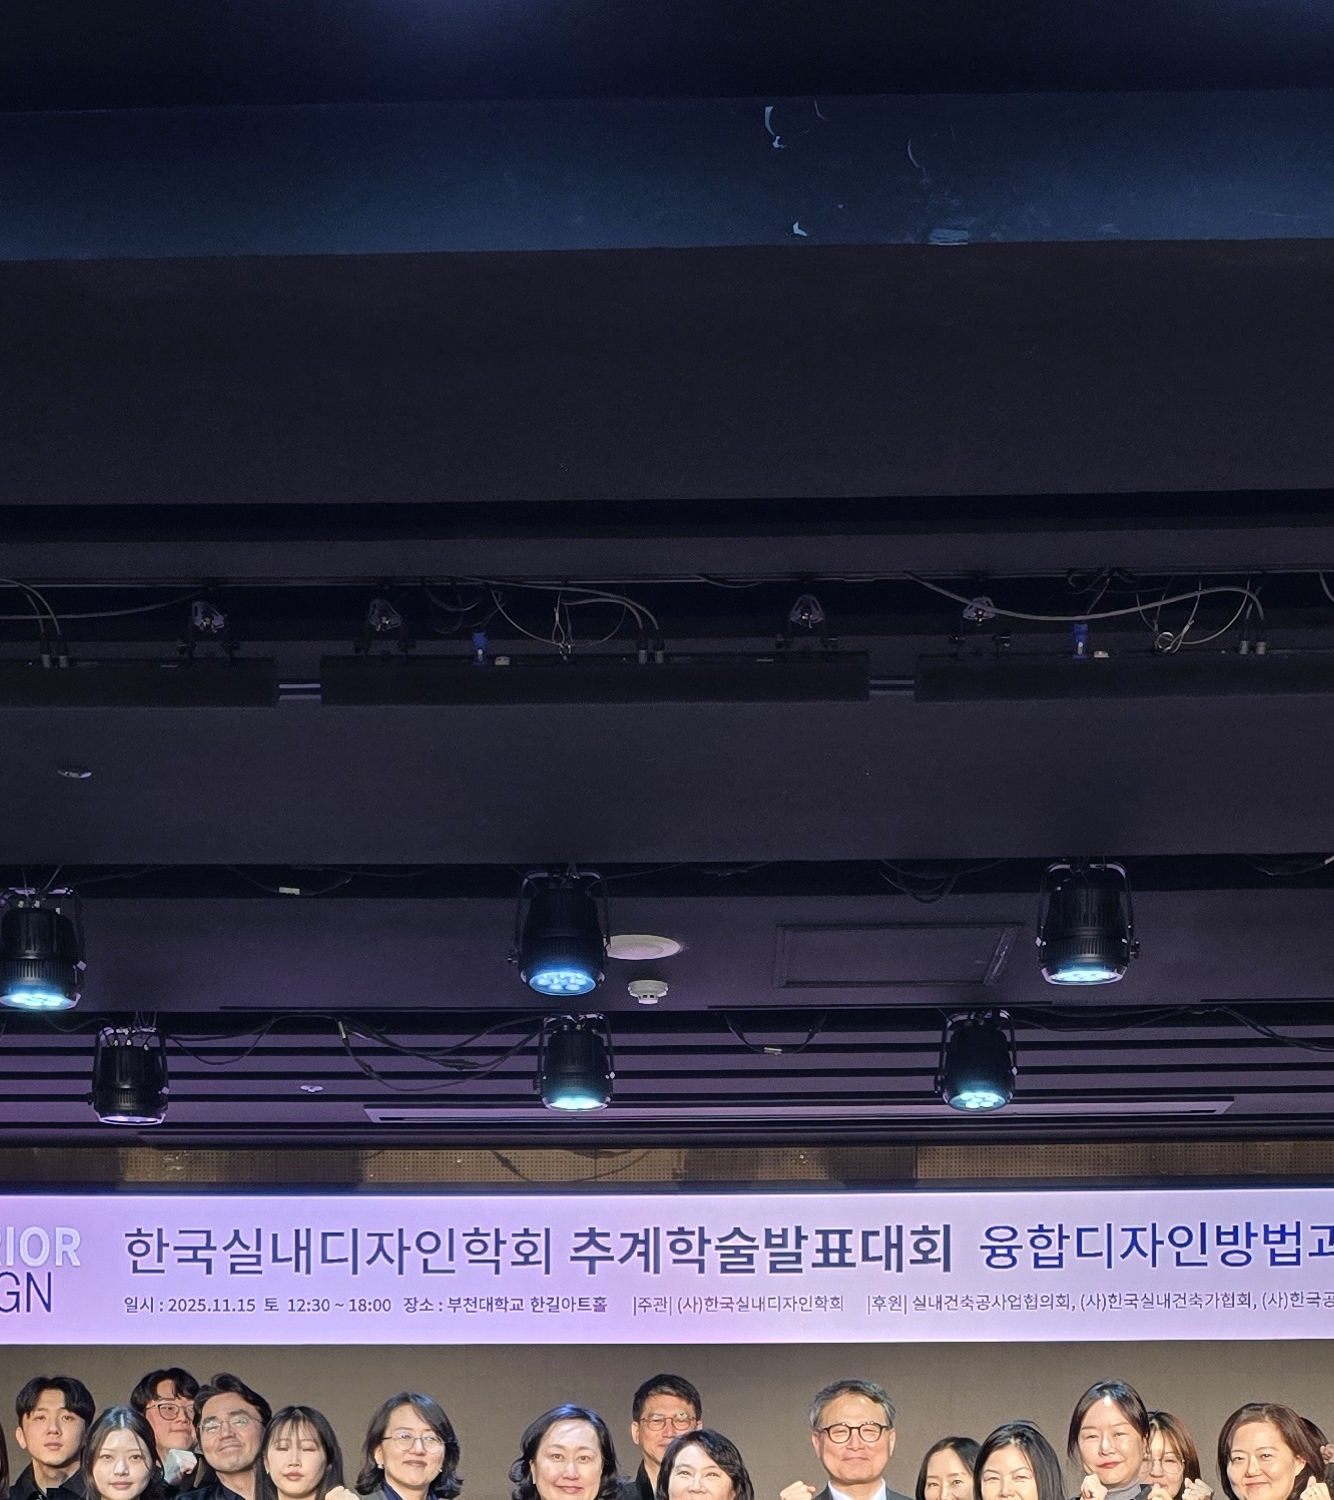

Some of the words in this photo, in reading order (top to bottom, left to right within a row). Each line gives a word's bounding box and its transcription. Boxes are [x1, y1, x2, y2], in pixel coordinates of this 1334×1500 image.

[124, 1226, 551, 1276] 한국실내디자인학회
[569, 1223, 952, 1276] 추계학술발표대회
[123, 1295, 154, 1314] 일시
[167, 1298, 256, 1313] 2025.11.15
[263, 1297, 280, 1313] 토
[287, 1298, 331, 1313] 12:30
[348, 1298, 392, 1313] 18:00
[403, 1296, 435, 1314] 장소
[446, 1296, 525, 1314] 부천대학교
[529, 1295, 608, 1314] 한길아트홀
[677, 1294, 844, 1315] (사)한국실내디자인학회
